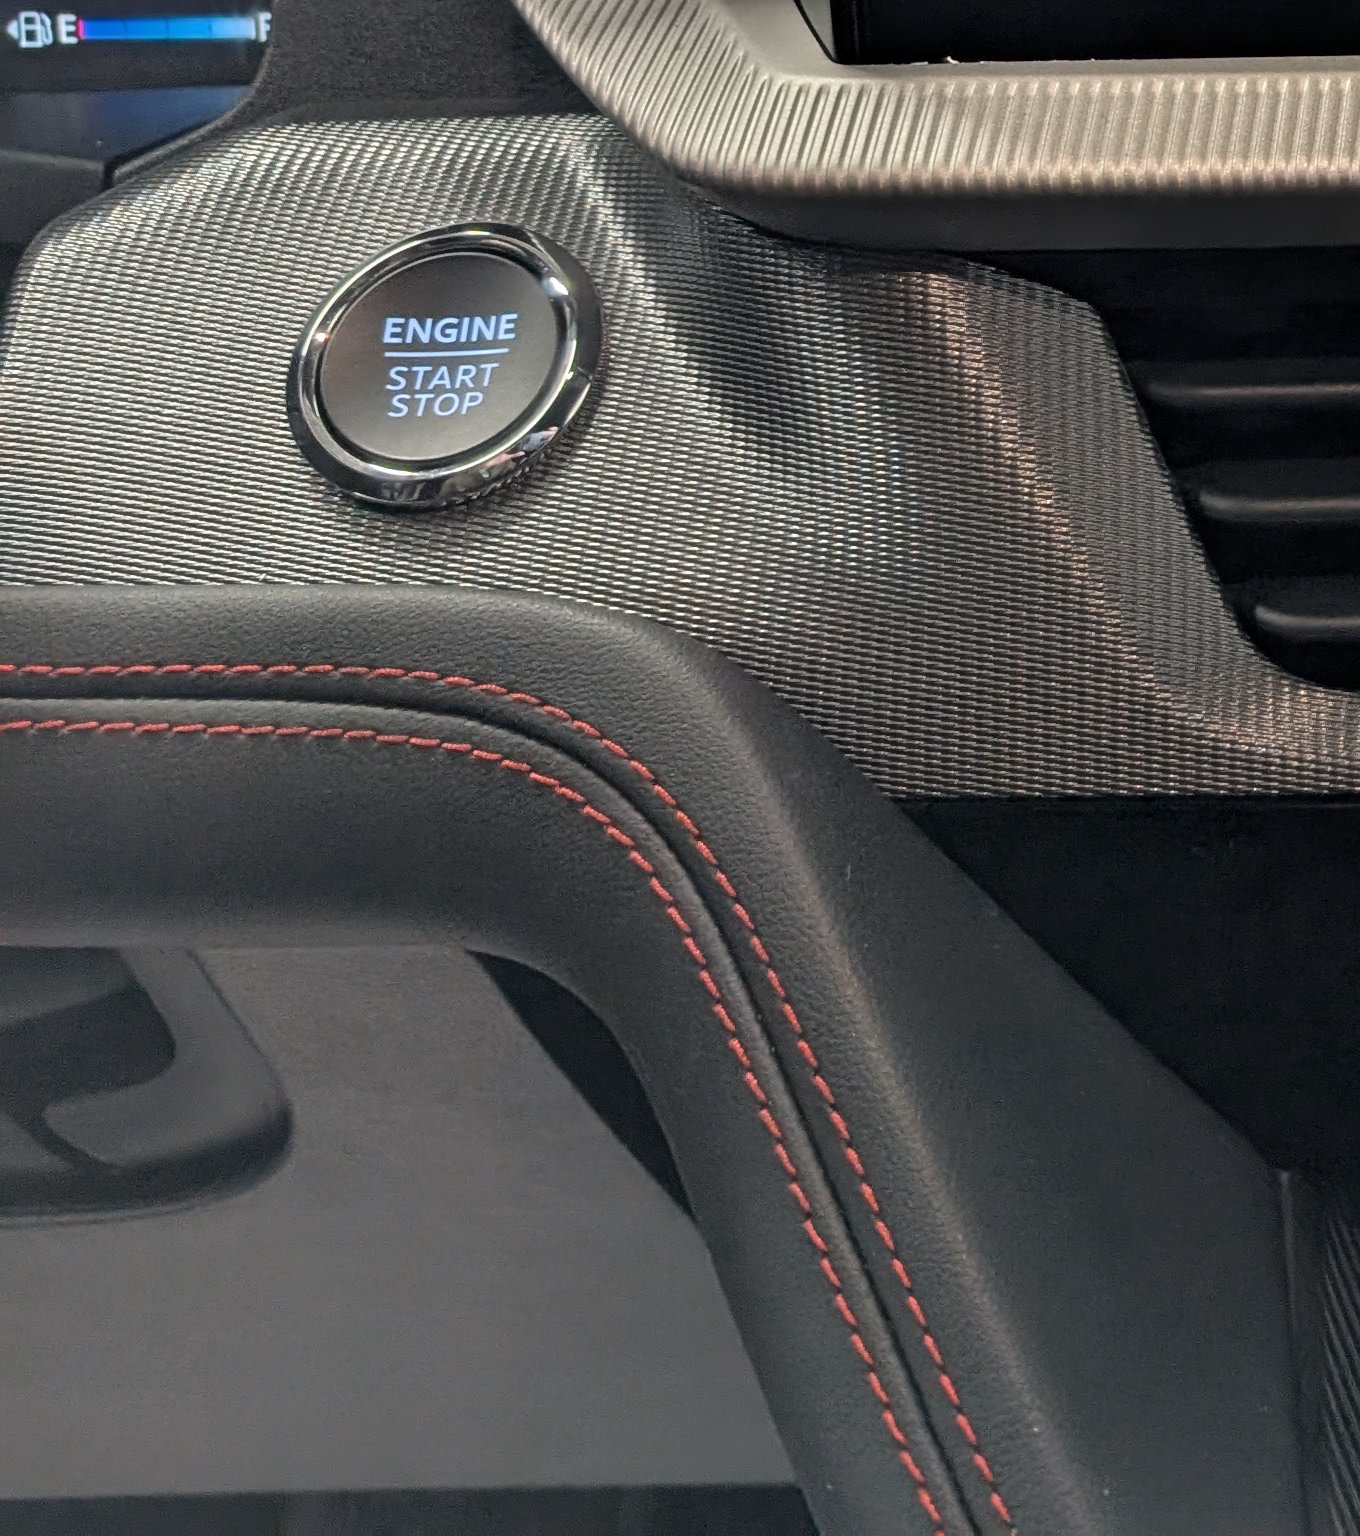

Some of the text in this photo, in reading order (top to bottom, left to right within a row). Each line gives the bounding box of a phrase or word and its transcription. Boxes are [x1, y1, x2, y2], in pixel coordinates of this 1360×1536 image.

[57, 14, 77, 45] E
[383, 314, 519, 345] ENGINE
[386, 362, 501, 391] START
[387, 390, 485, 419] STOP
